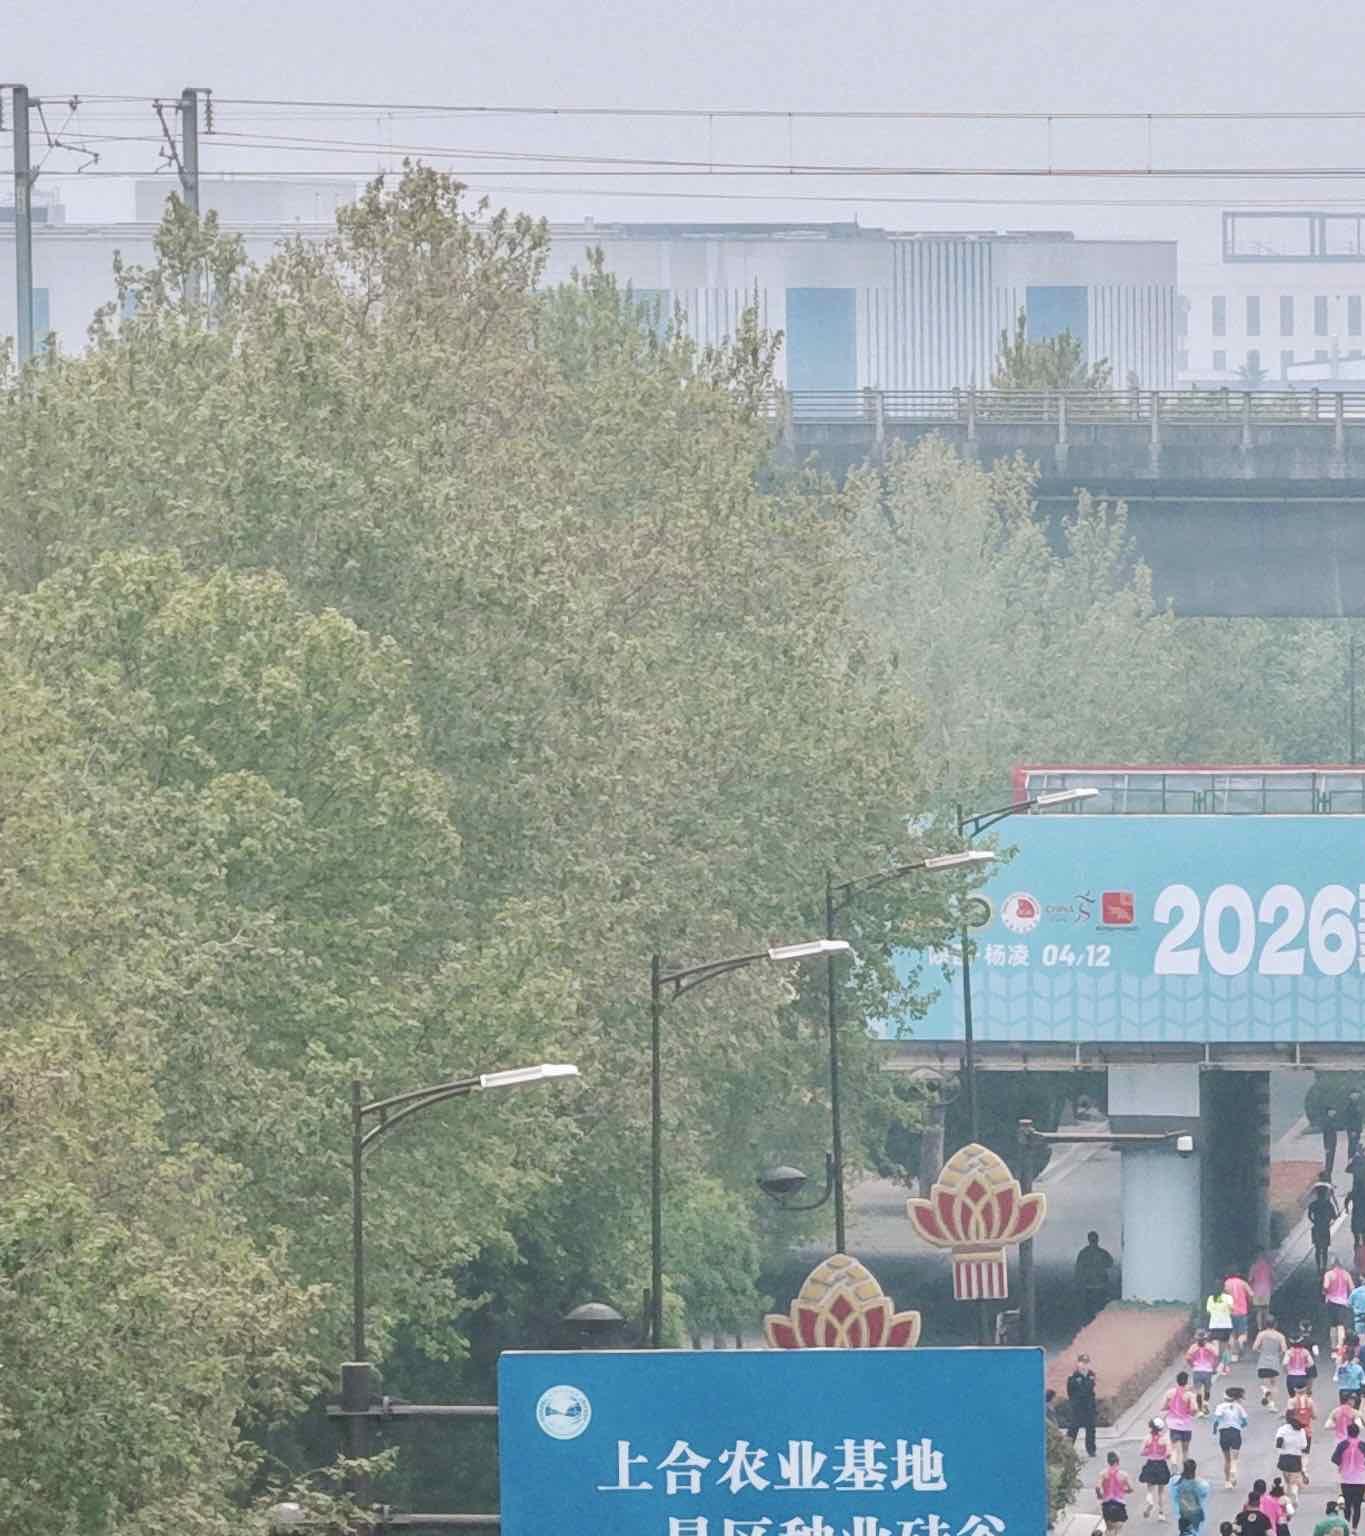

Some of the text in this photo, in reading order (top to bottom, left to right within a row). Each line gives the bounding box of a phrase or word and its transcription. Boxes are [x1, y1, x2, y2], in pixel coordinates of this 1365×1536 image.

[597, 1438, 948, 1495] 上合农业基地
